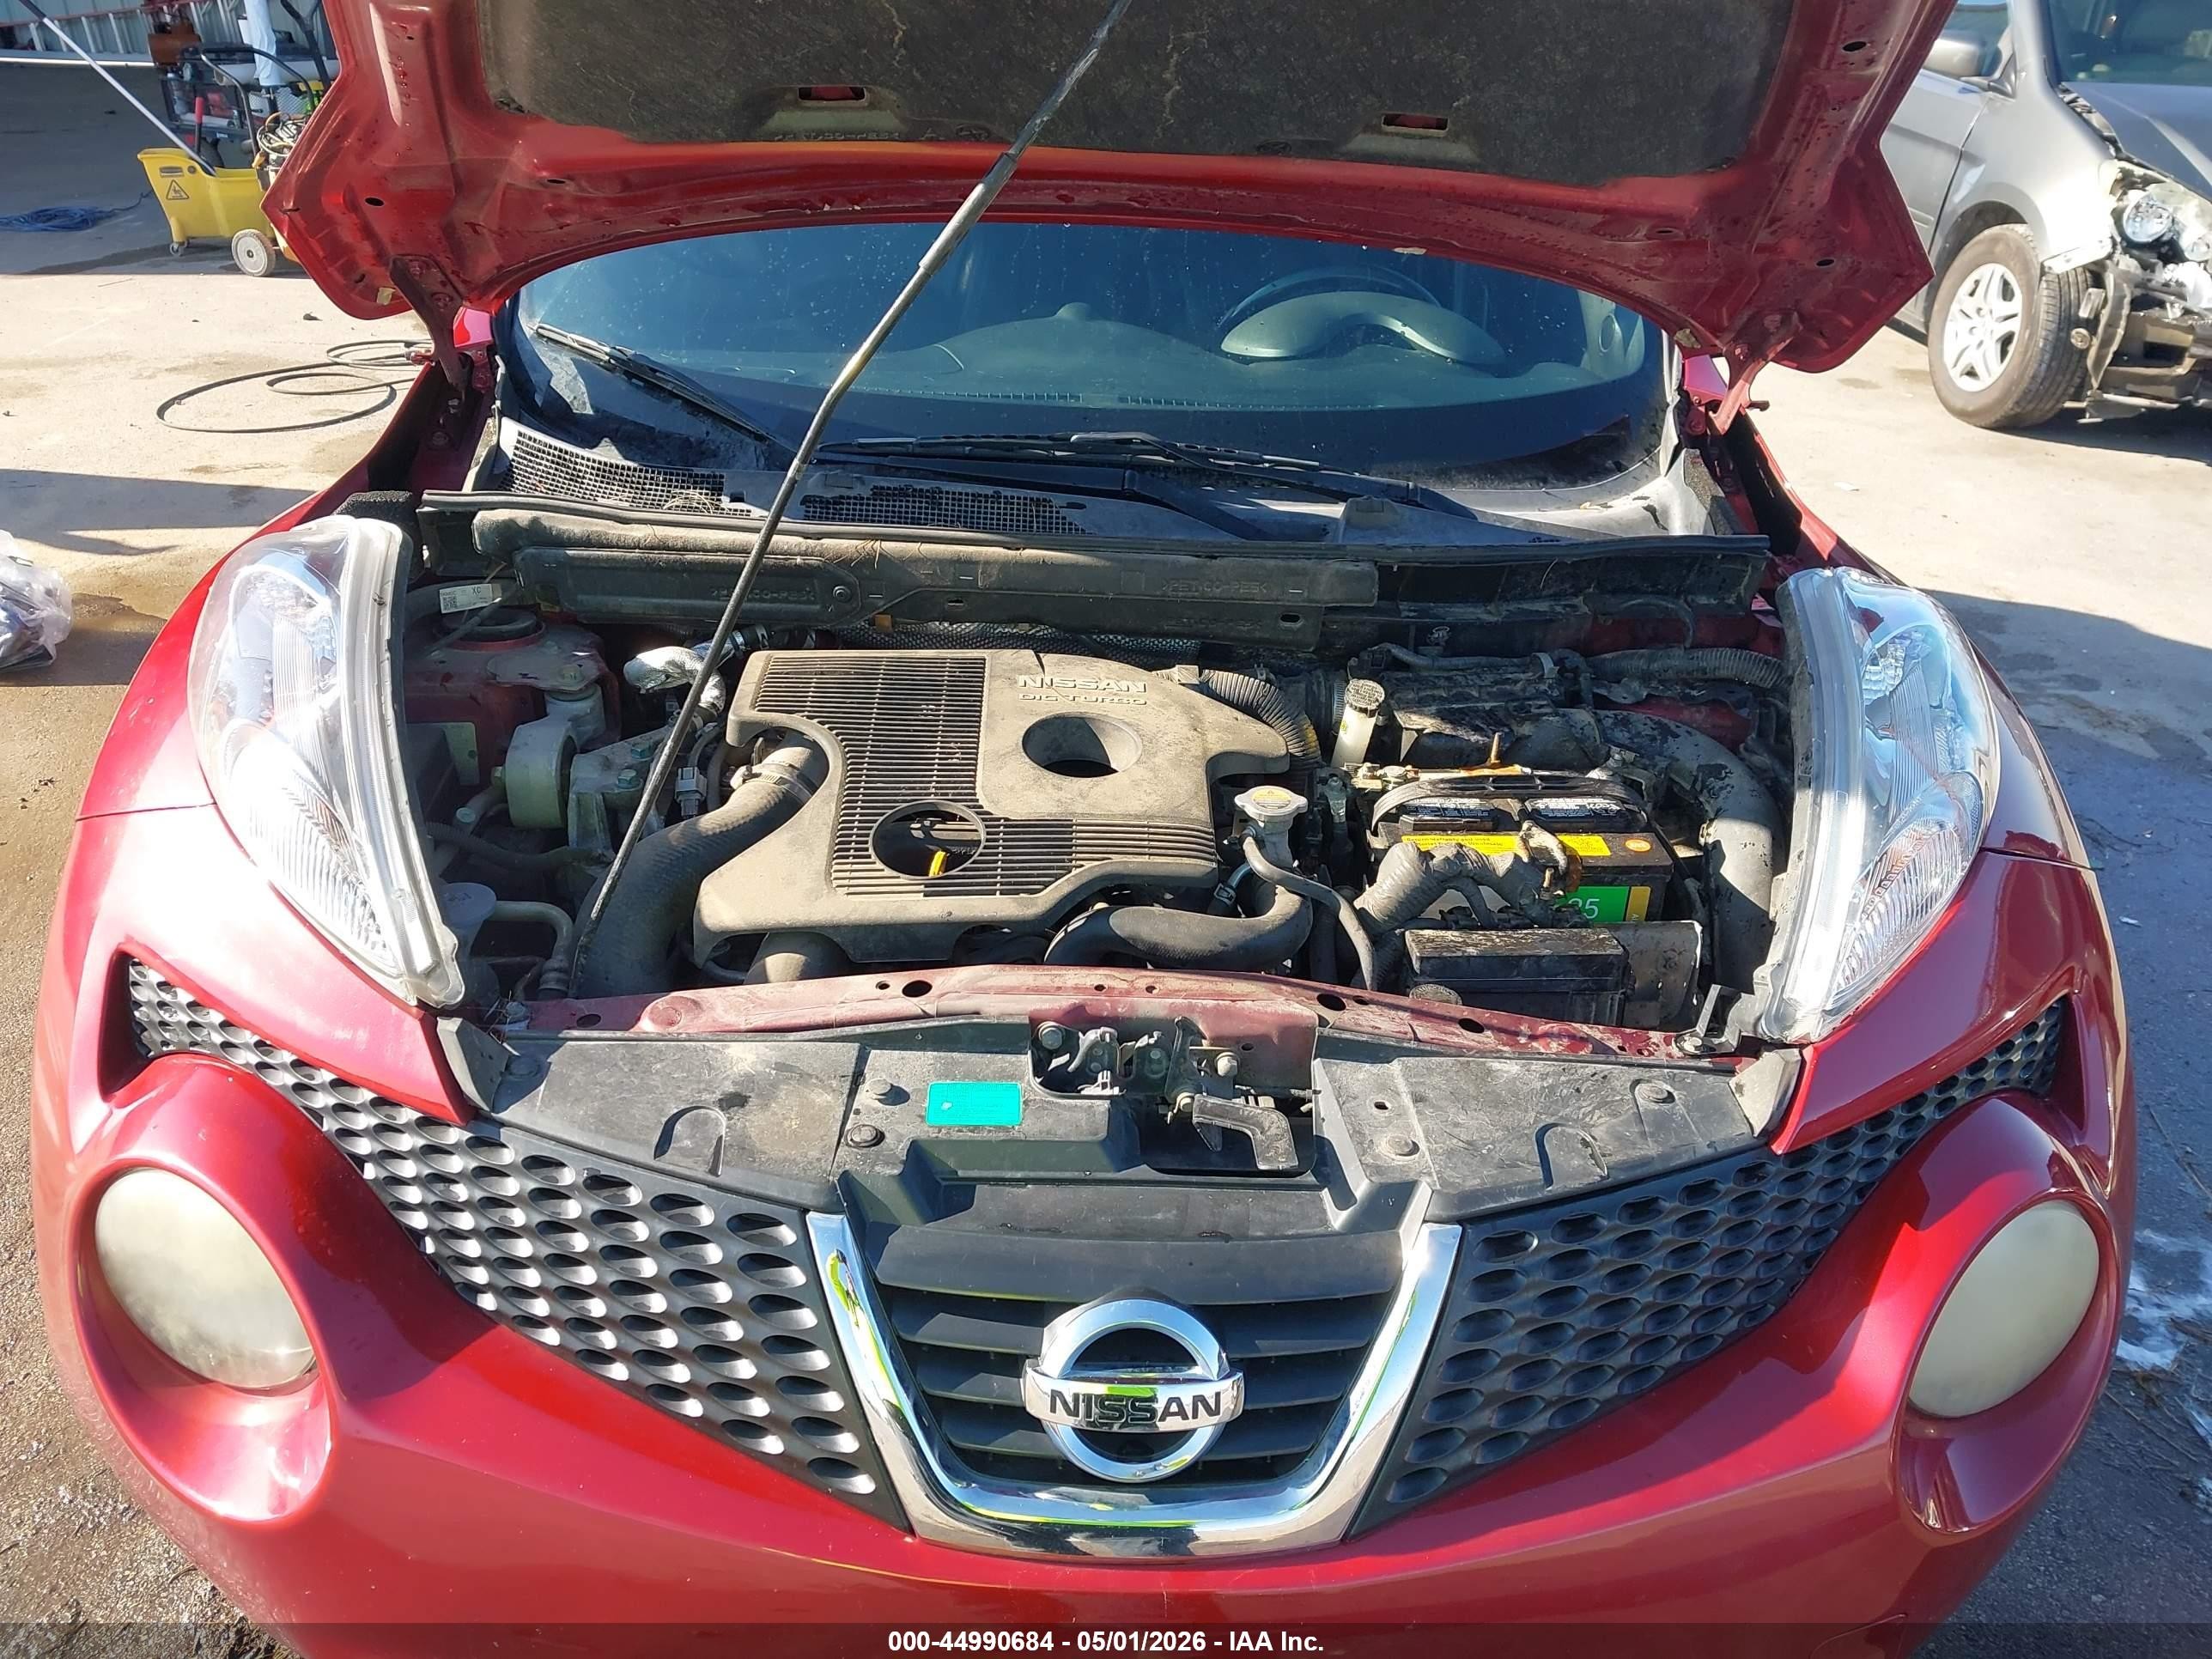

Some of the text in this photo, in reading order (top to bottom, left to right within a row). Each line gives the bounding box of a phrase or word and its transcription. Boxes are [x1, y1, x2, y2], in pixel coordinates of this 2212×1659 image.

[1018, 675, 1147, 693] NISSAN
[1061, 694, 1147, 706] TURBO
[1049, 1388, 1221, 1424] NISSAN
